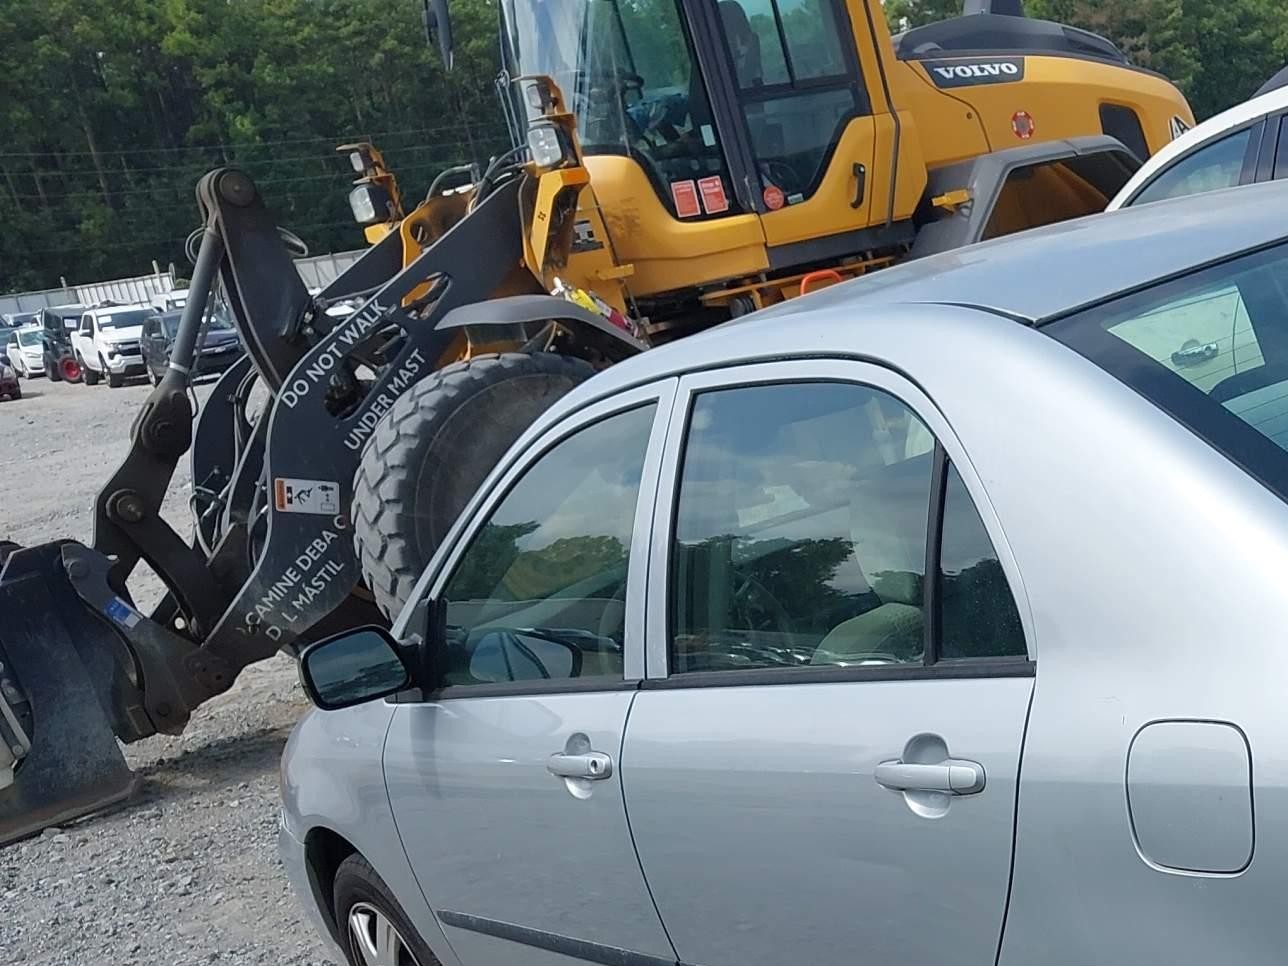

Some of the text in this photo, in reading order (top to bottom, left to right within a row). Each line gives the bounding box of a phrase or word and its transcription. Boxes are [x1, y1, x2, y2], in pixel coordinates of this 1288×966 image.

[933, 62, 1018, 80] VOLVO
[281, 299, 388, 408] DO NOT WALK
[344, 348, 427, 450] UNDER MAST
[291, 560, 345, 611] MÁSTIL
